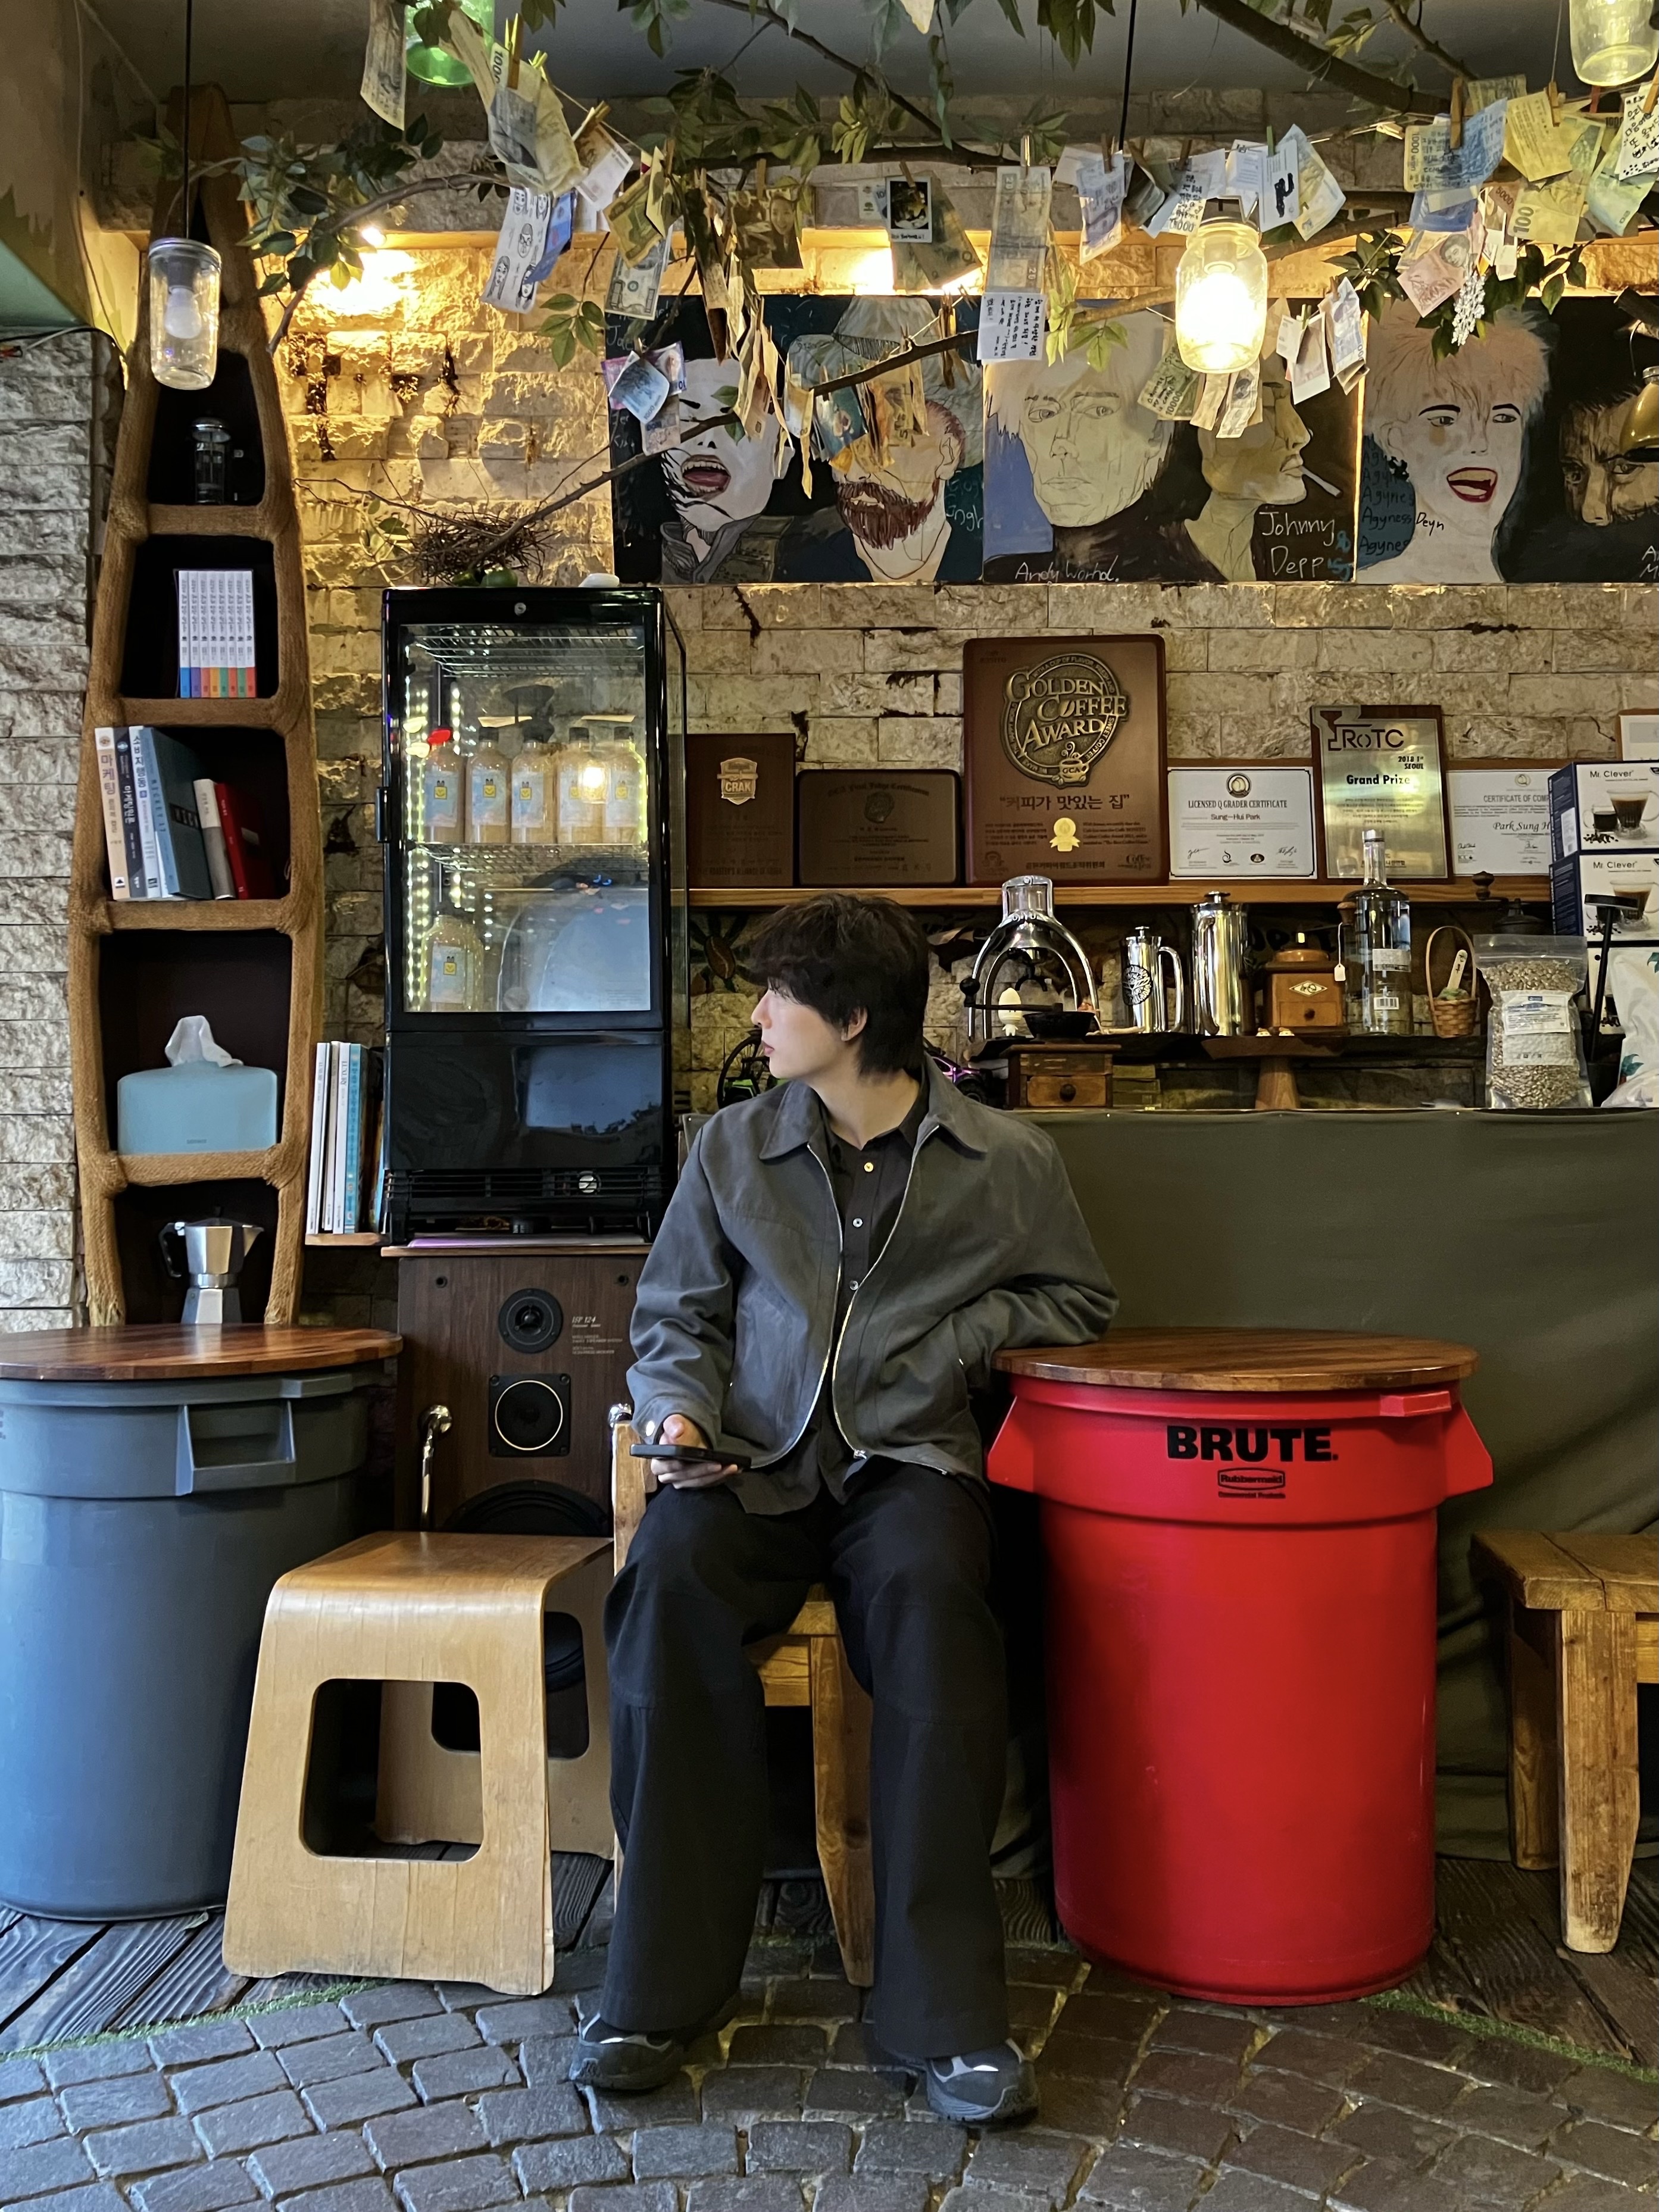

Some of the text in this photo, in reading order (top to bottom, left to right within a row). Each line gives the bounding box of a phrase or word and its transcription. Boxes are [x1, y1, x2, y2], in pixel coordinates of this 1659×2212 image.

[1513, 207, 1534, 233] 100
[1166, 390, 1183, 415] 10000
[1259, 512, 1335, 546] Johnny
[1361, 507, 1444, 536] Agyness Deyn
[1015, 562, 1060, 583] Andy
[1270, 545, 1324, 579] Depp
[1006, 671, 1105, 701] GOLDEN
[1038, 695, 1127, 721] COFFEE
[1017, 718, 1105, 758] AWARD
[725, 782, 751, 792] CRAK
[1346, 774, 1410, 785] Grand Prize
[1057, 795, 1102, 810] 맛있는
[1188, 799, 1288, 810] LICENSED Q GRADER CERTIFICATE
[1493, 821, 1517, 832] Park
[1517, 821, 1539, 832] Sung
[1167, 1425, 1332, 1462] BRUTE
[1220, 1474, 1283, 1484] Rubbermaid
